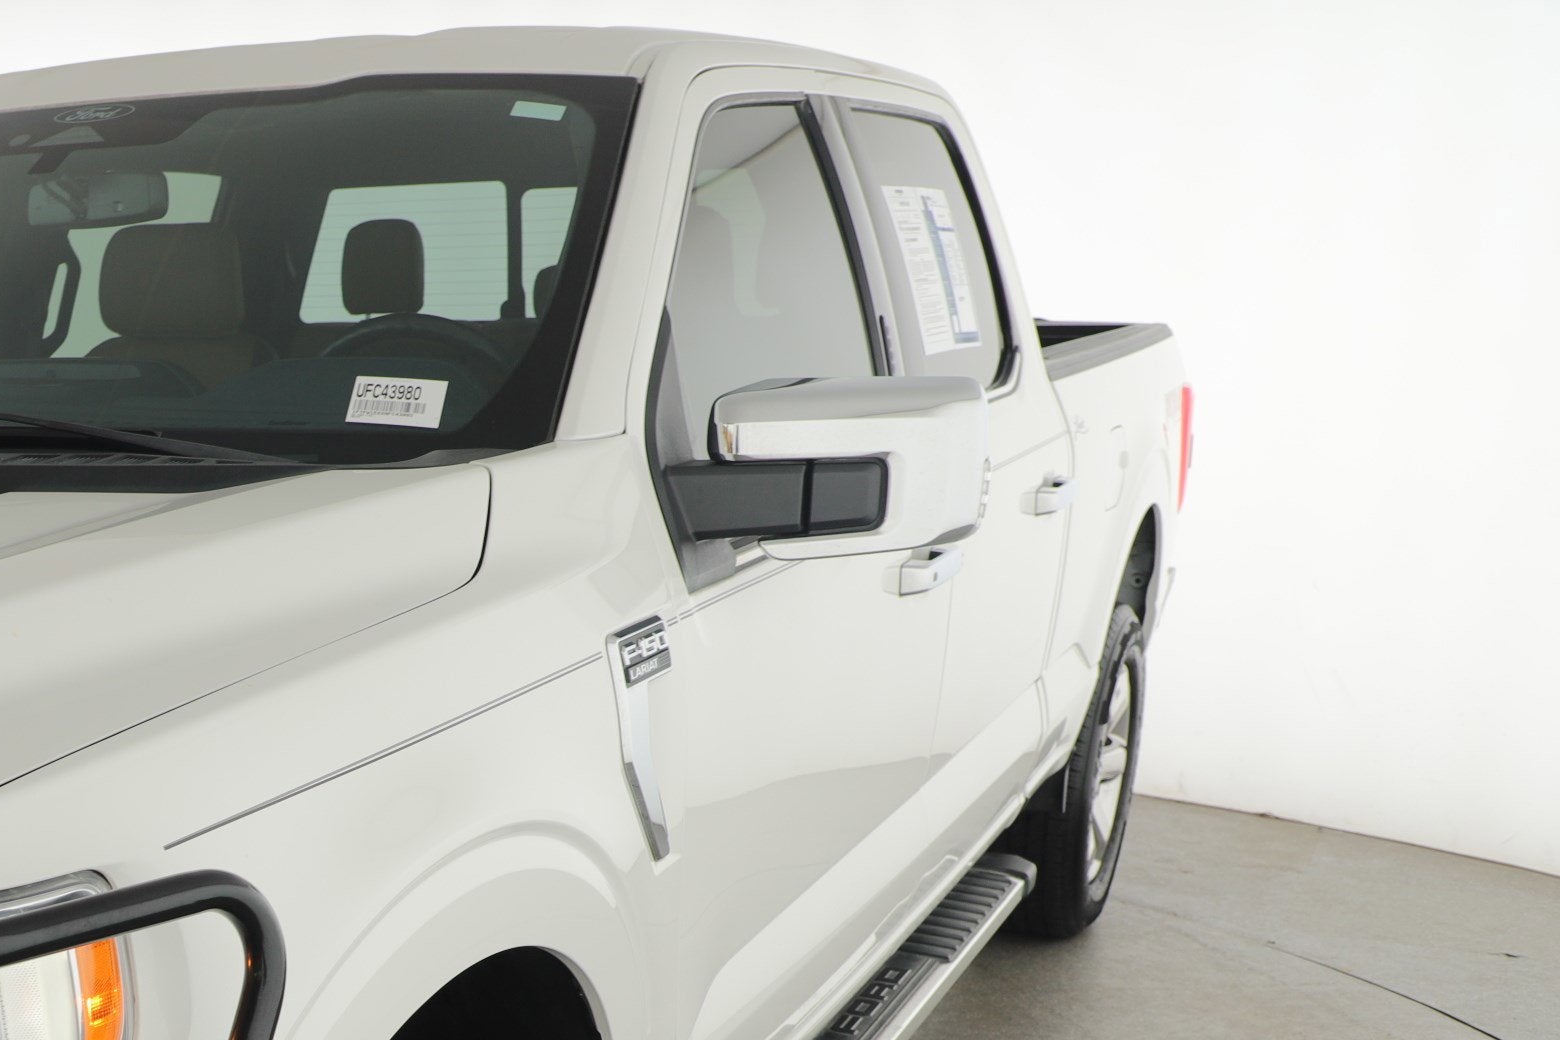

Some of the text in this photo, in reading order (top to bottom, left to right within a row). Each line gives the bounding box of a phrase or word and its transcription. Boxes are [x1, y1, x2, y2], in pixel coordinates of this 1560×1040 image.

[356, 383, 423, 401] UFC43980
[628, 657, 659, 681] LARIAT
[830, 966, 913, 1036] FORD
